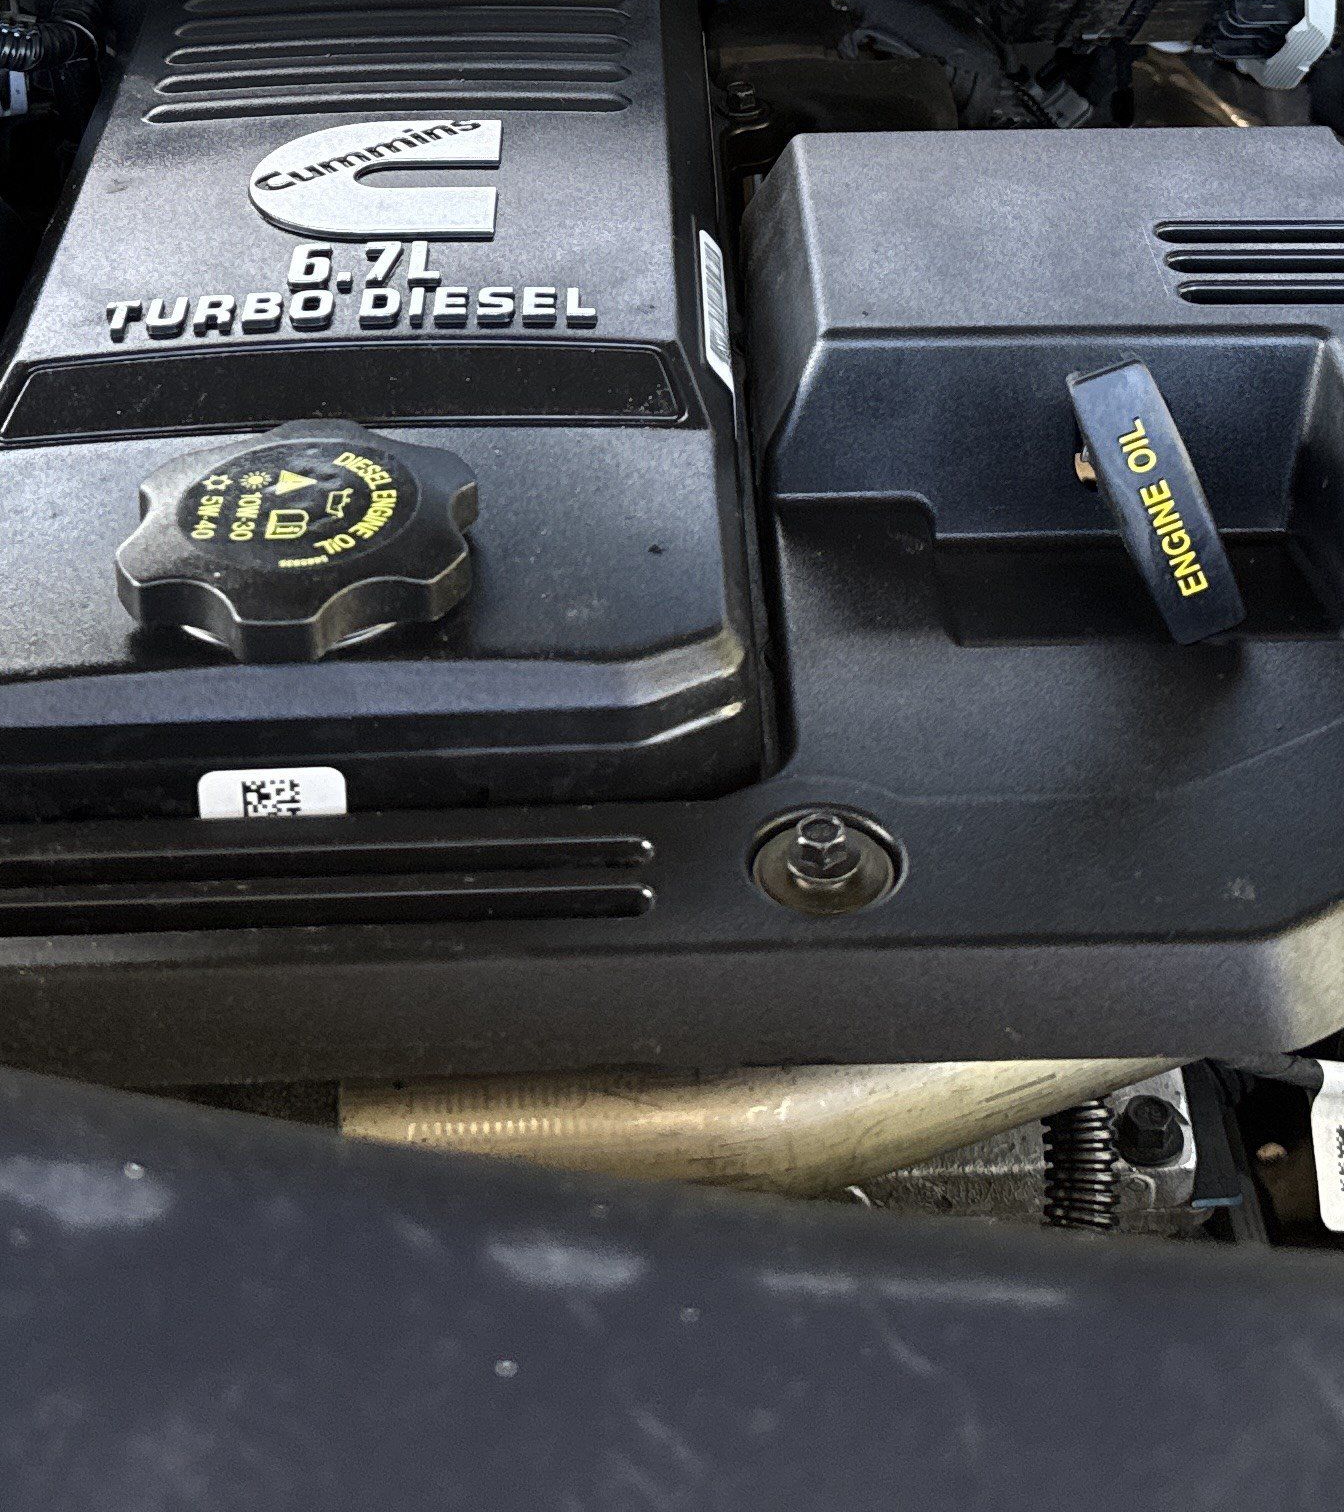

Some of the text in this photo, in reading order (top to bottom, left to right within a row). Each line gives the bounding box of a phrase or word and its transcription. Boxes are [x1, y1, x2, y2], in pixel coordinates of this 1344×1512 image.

[254, 117, 483, 192] Cummins
[286, 240, 441, 292] 6.7L
[105, 286, 599, 342] TURBO DIESEL
[190, 494, 225, 540] 5W-40
[228, 491, 263, 541] 10W-30
[312, 451, 398, 555] DIESEL ENGINE OIL
[1118, 418, 1209, 597] ENGINE OIL
